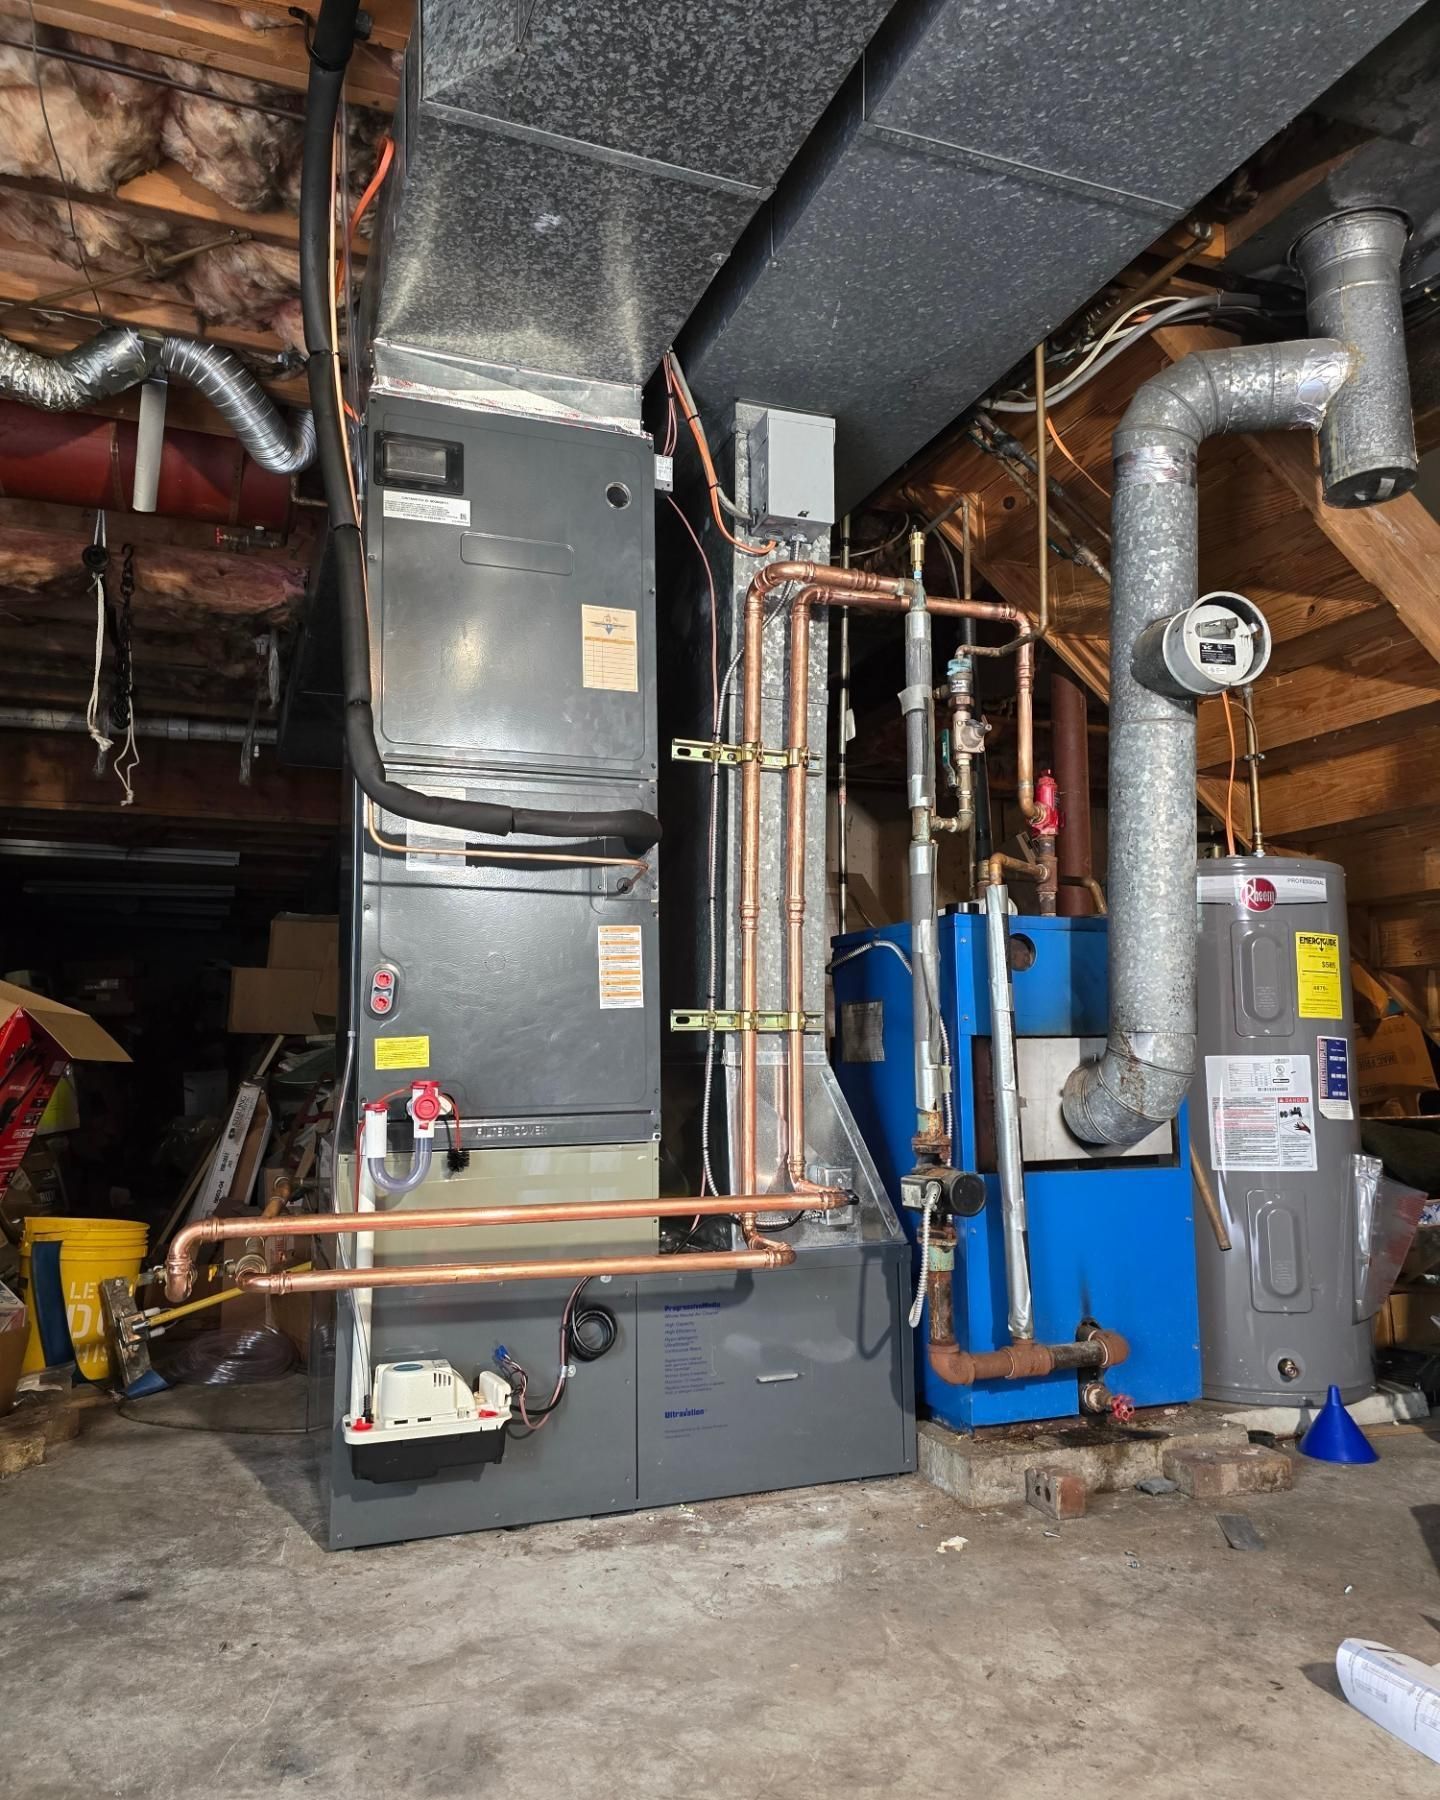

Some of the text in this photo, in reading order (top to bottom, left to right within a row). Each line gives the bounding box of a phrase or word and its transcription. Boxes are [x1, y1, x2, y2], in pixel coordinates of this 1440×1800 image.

[1287, 878, 1324, 886] PROFESSIONAL
[1242, 879, 1275, 906] Rheem
[476, 1125, 547, 1137] FILTER COVER
